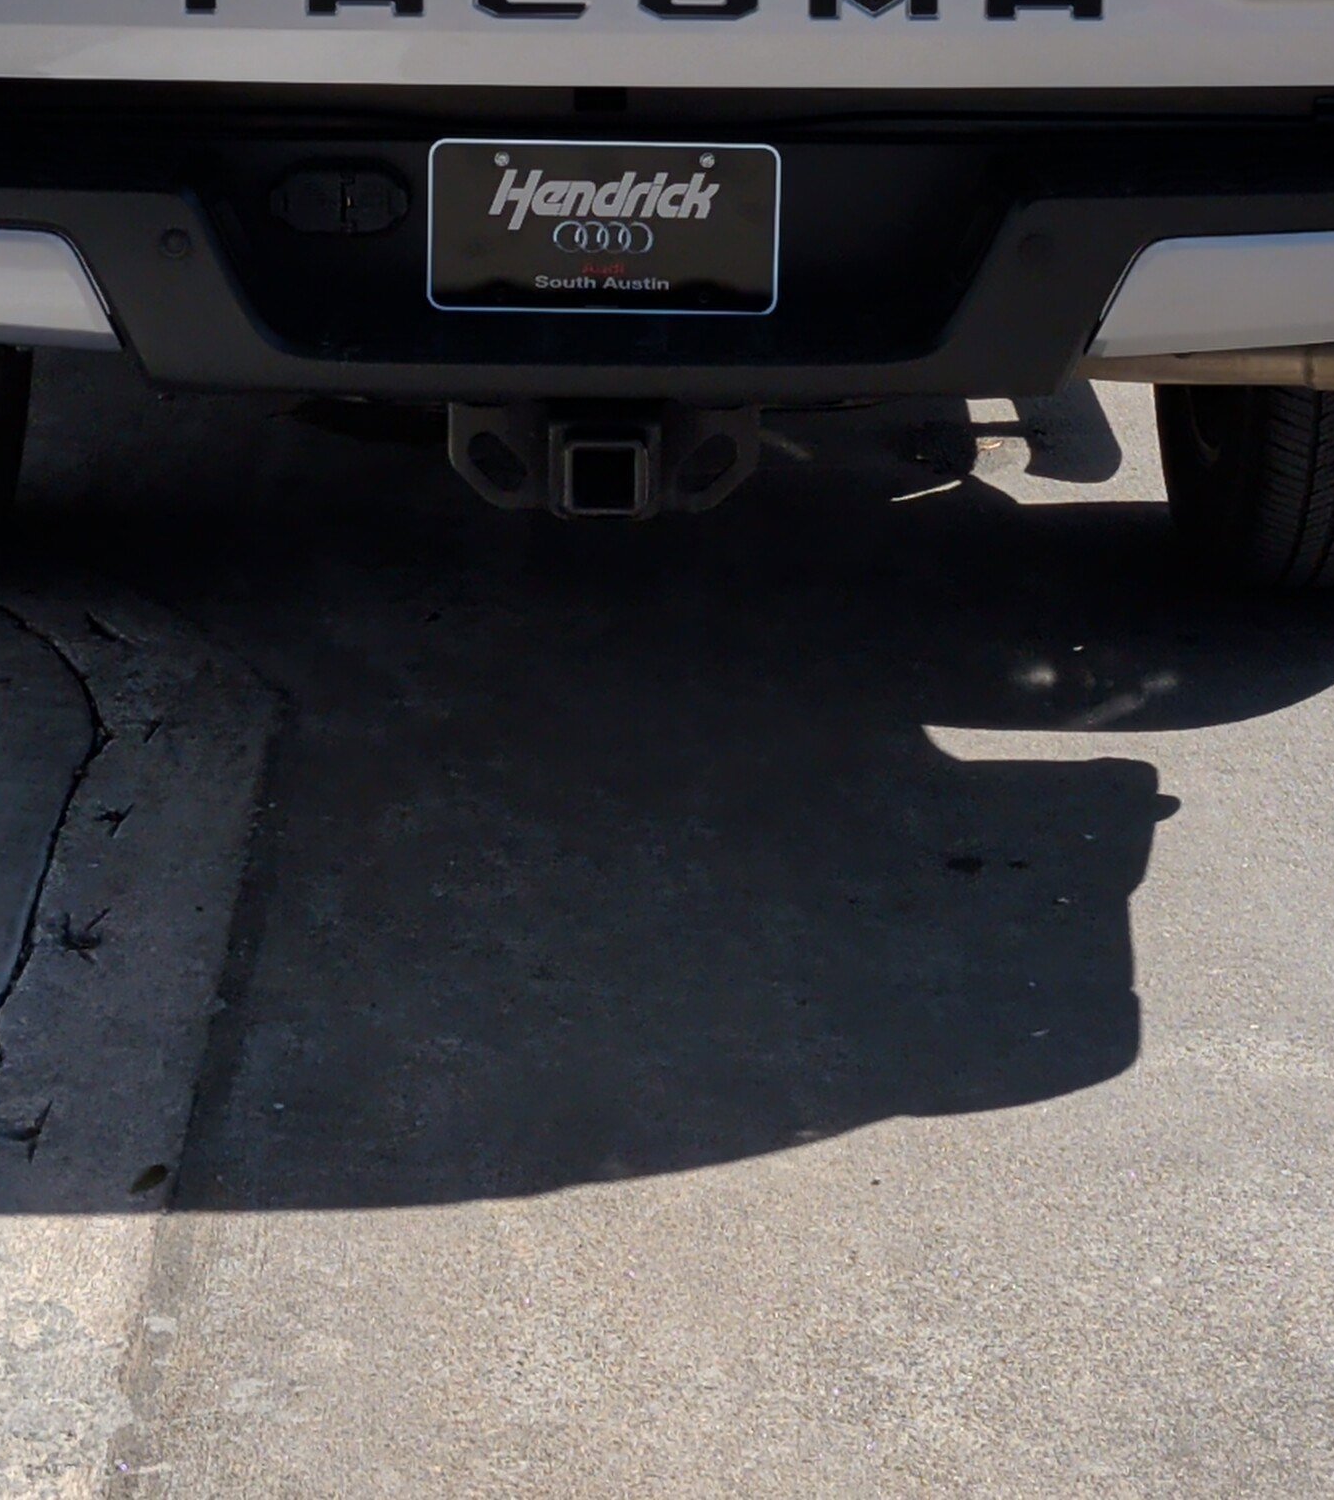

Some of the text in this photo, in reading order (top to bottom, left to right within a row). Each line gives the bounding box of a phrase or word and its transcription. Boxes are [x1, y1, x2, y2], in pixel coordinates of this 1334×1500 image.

[487, 169, 721, 231] Hendrick
[534, 275, 670, 291] South Austin
